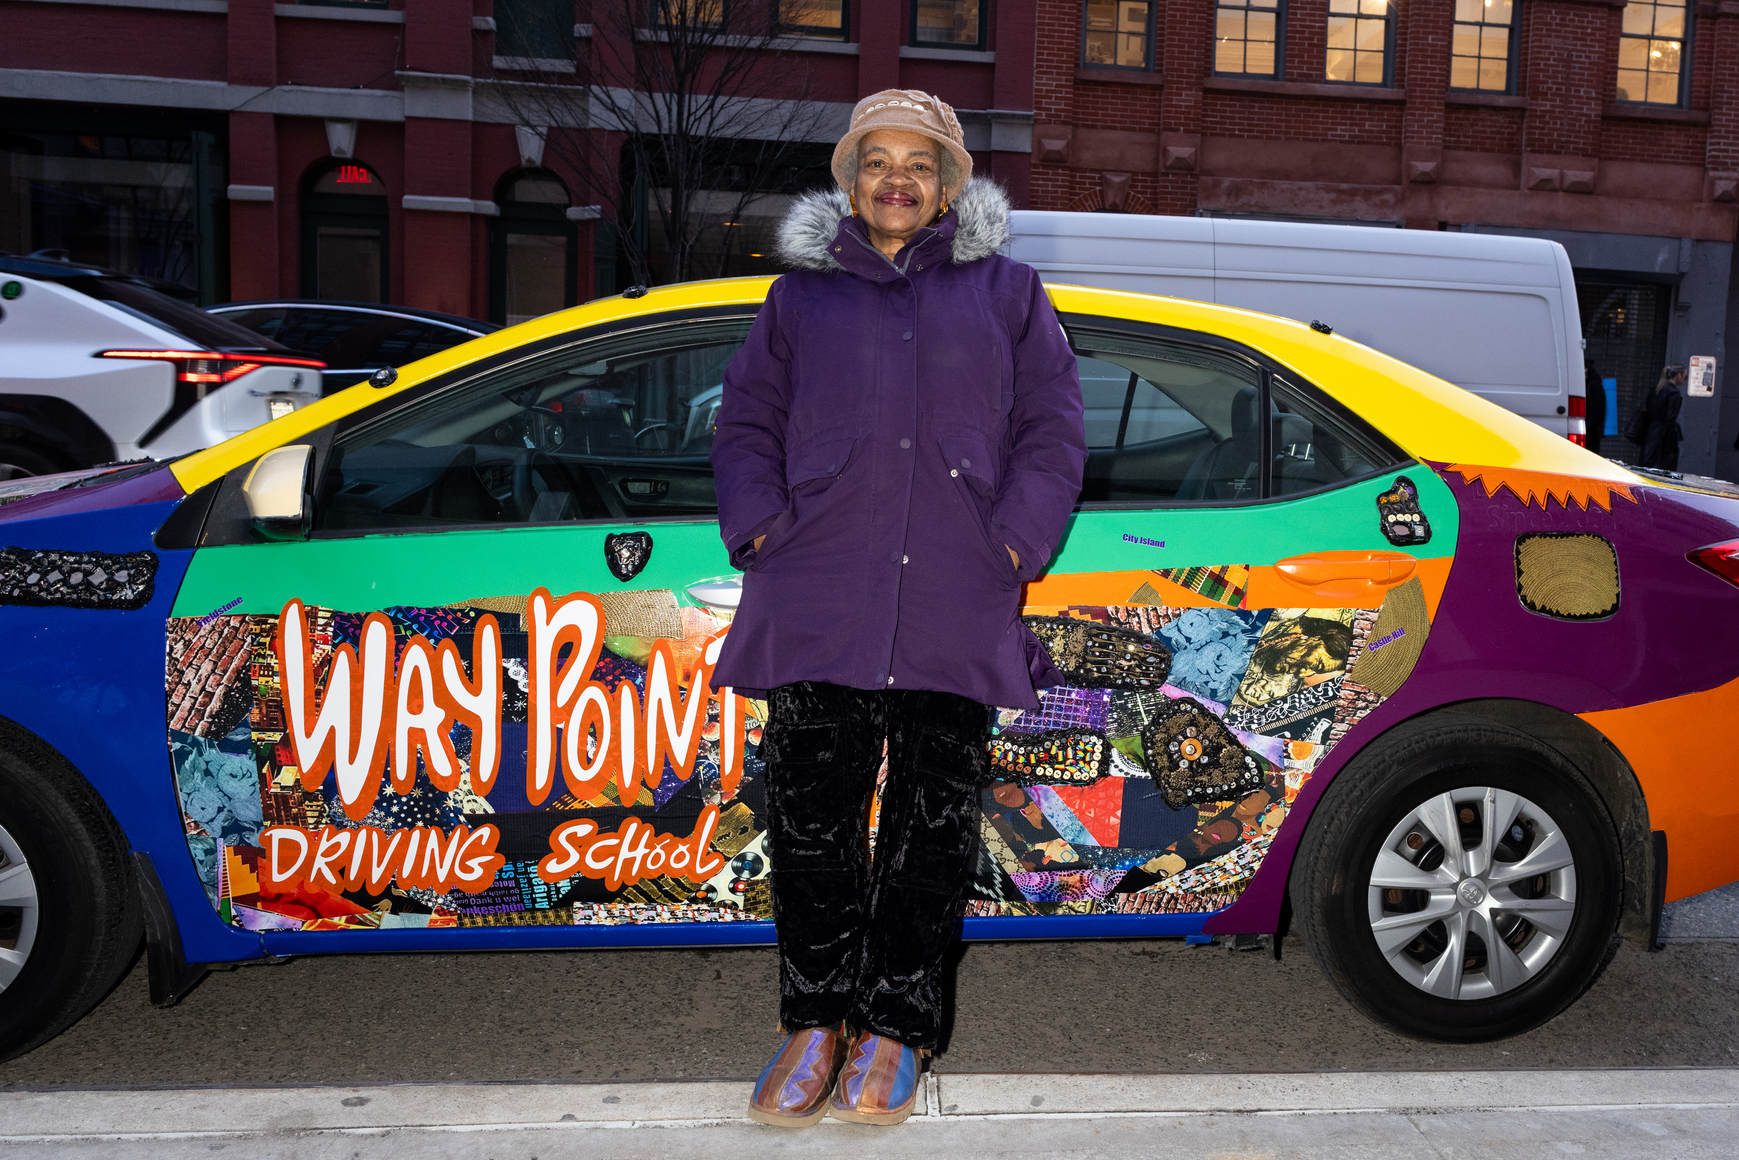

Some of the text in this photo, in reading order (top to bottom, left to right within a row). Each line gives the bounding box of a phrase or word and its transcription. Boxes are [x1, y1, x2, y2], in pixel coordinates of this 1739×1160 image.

[1122, 533, 1166, 549] City Island
[196, 597, 244, 628] Fieldstone
[1368, 627, 1406, 652] Castle Hill
[284, 602, 497, 806] WAY
[265, 826, 495, 886] DRIVING
[461, 902, 525, 914] ankeschön
[470, 896, 494, 905] Dank
[503, 895, 521, 903] wel
